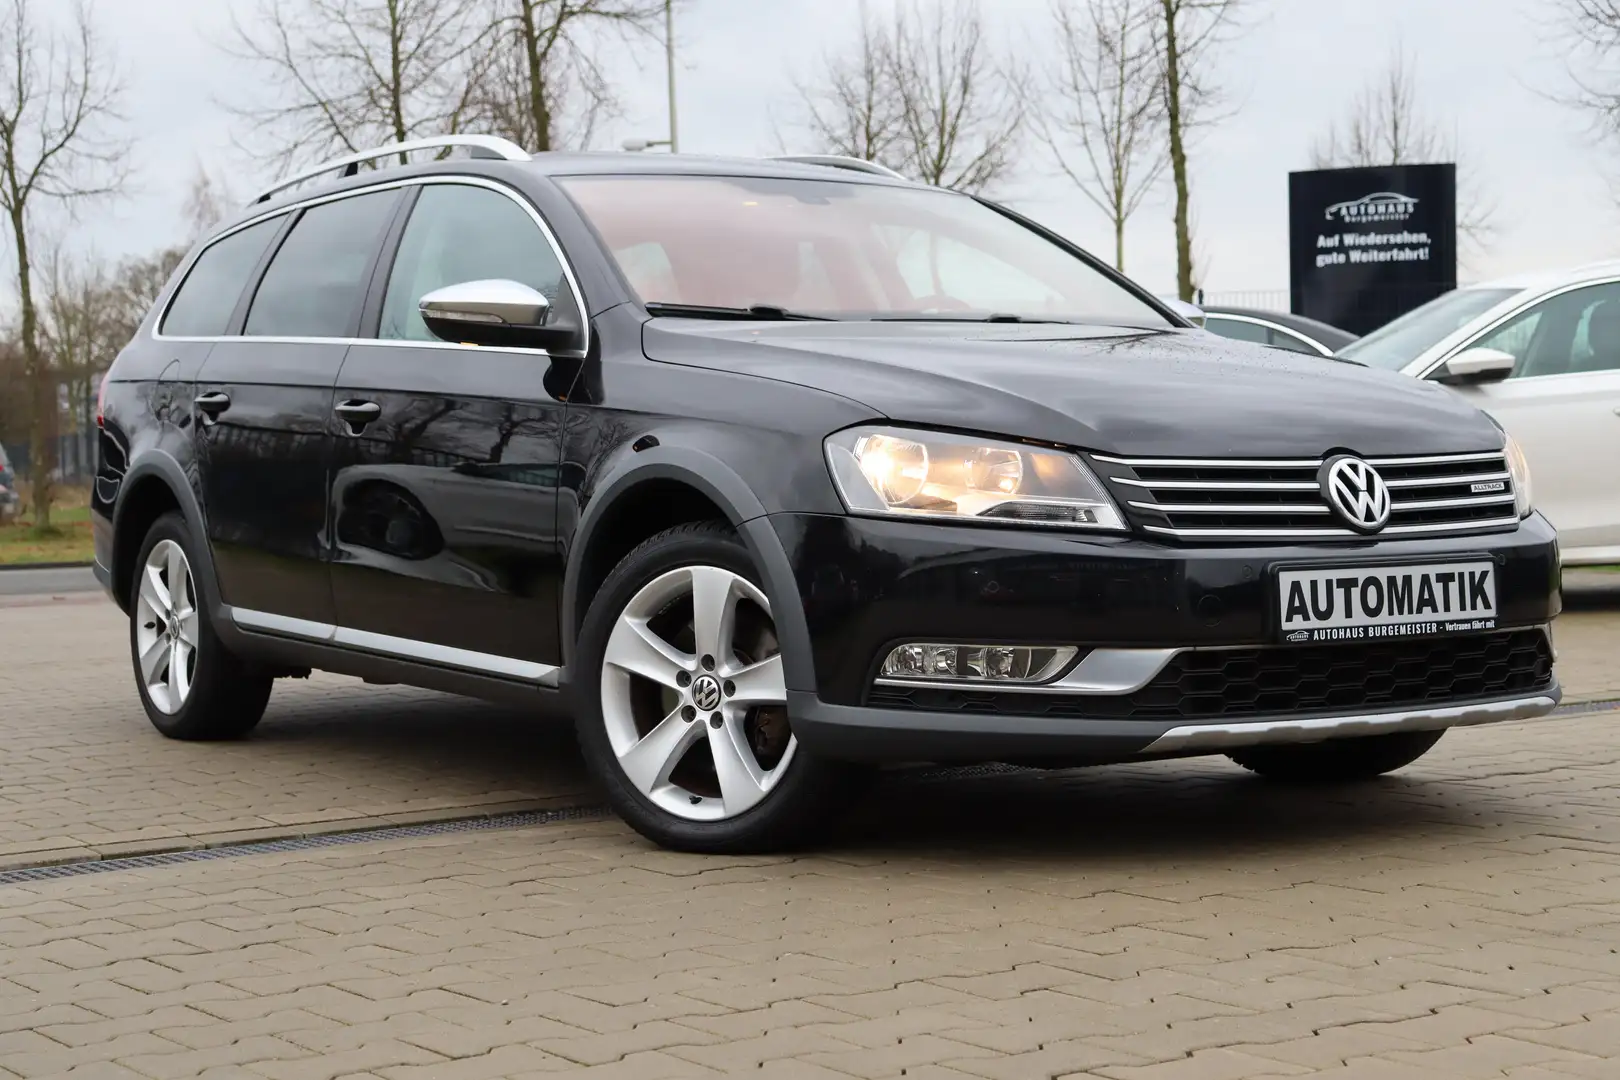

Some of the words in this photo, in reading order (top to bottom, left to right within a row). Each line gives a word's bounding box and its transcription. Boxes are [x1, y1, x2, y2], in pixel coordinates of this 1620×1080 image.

[1340, 203, 1415, 216] AUTOHAUS
[1317, 234, 1341, 248] Auf
[1343, 230, 1432, 246] Wiedersehen,
[1316, 251, 1346, 268] gute
[1349, 246, 1430, 264] Weiterfahrt!
[1329, 458, 1390, 528] VW
[1473, 483, 1504, 491] ALLTRACK
[1284, 570, 1493, 623] AUTOMATIK
[1313, 627, 1364, 640] AUTOHAUS
[1368, 622, 1437, 637] BURGEMEISTER
